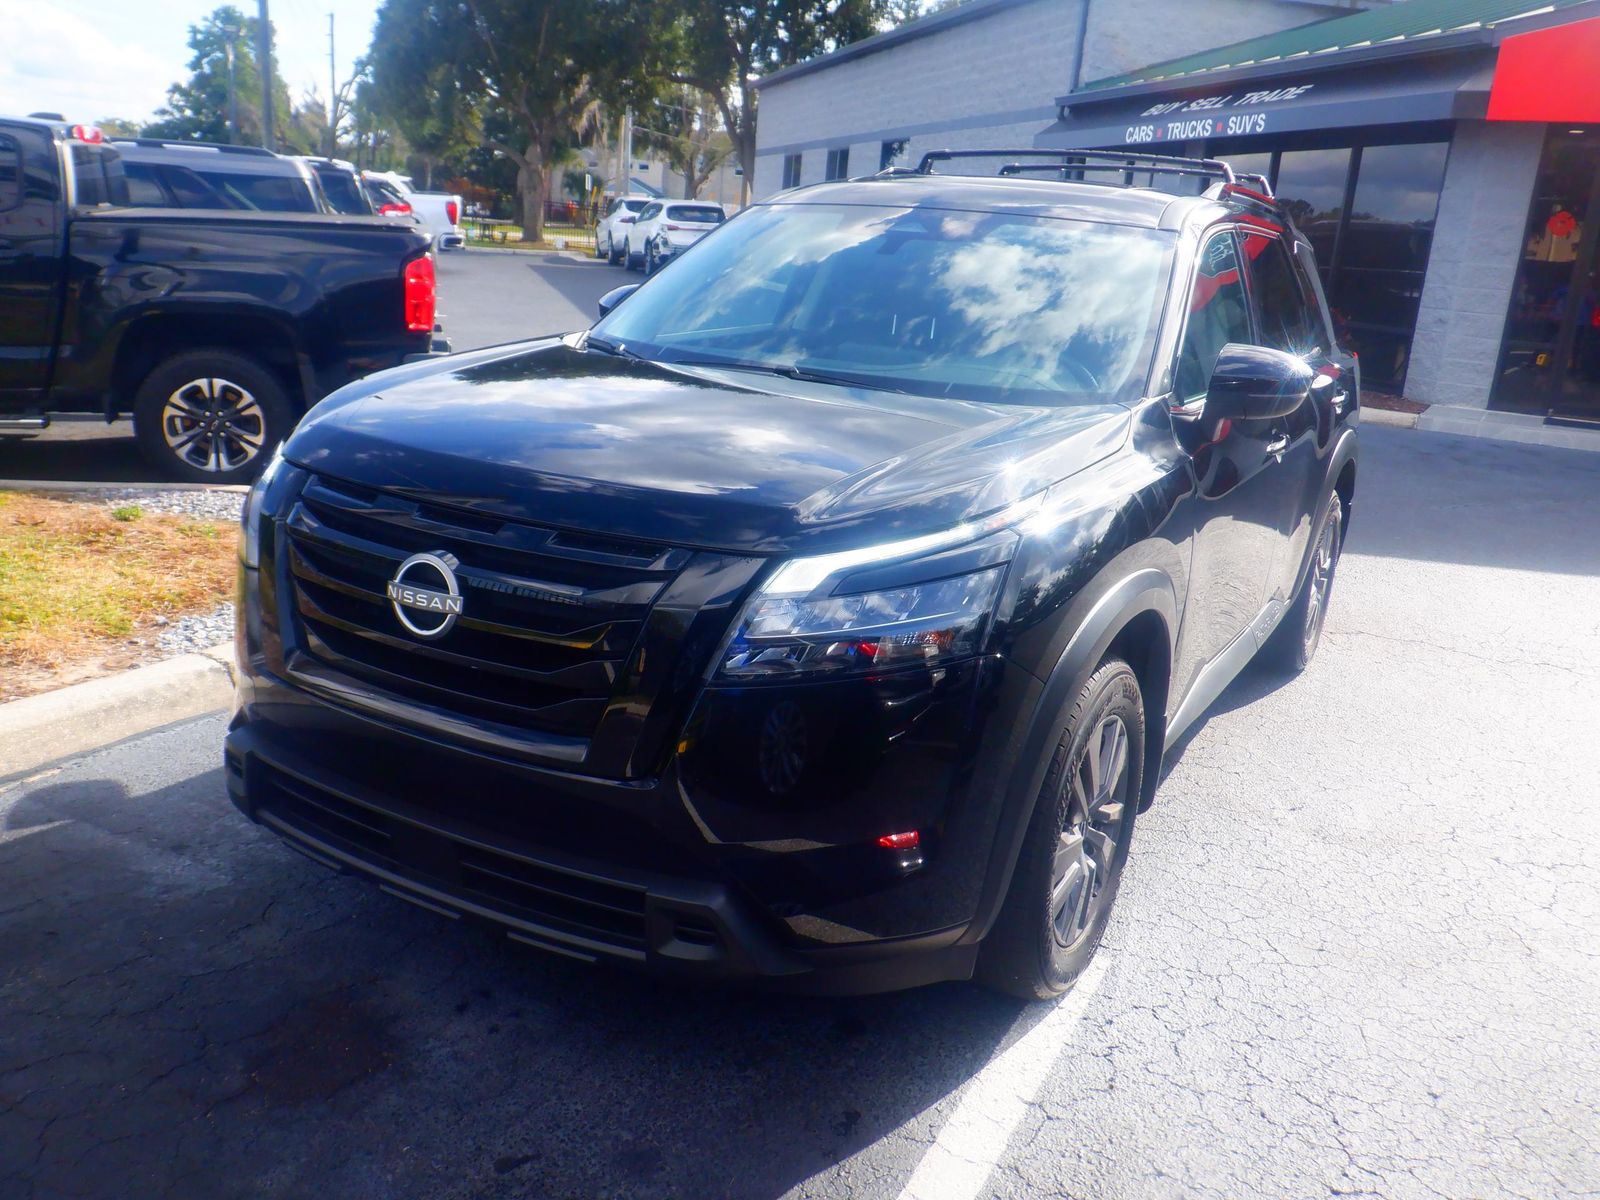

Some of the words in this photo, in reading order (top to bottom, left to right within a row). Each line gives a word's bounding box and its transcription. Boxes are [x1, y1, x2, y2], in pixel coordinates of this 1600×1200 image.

[1140, 101, 1187, 117] BUY
[1181, 95, 1232, 112] SELL
[1233, 84, 1315, 106] TRADE
[1125, 126, 1154, 143] CARS
[1167, 119, 1212, 139] TRUCKS
[1227, 113, 1266, 135] SUV'S
[387, 584, 460, 612] NISSAN
